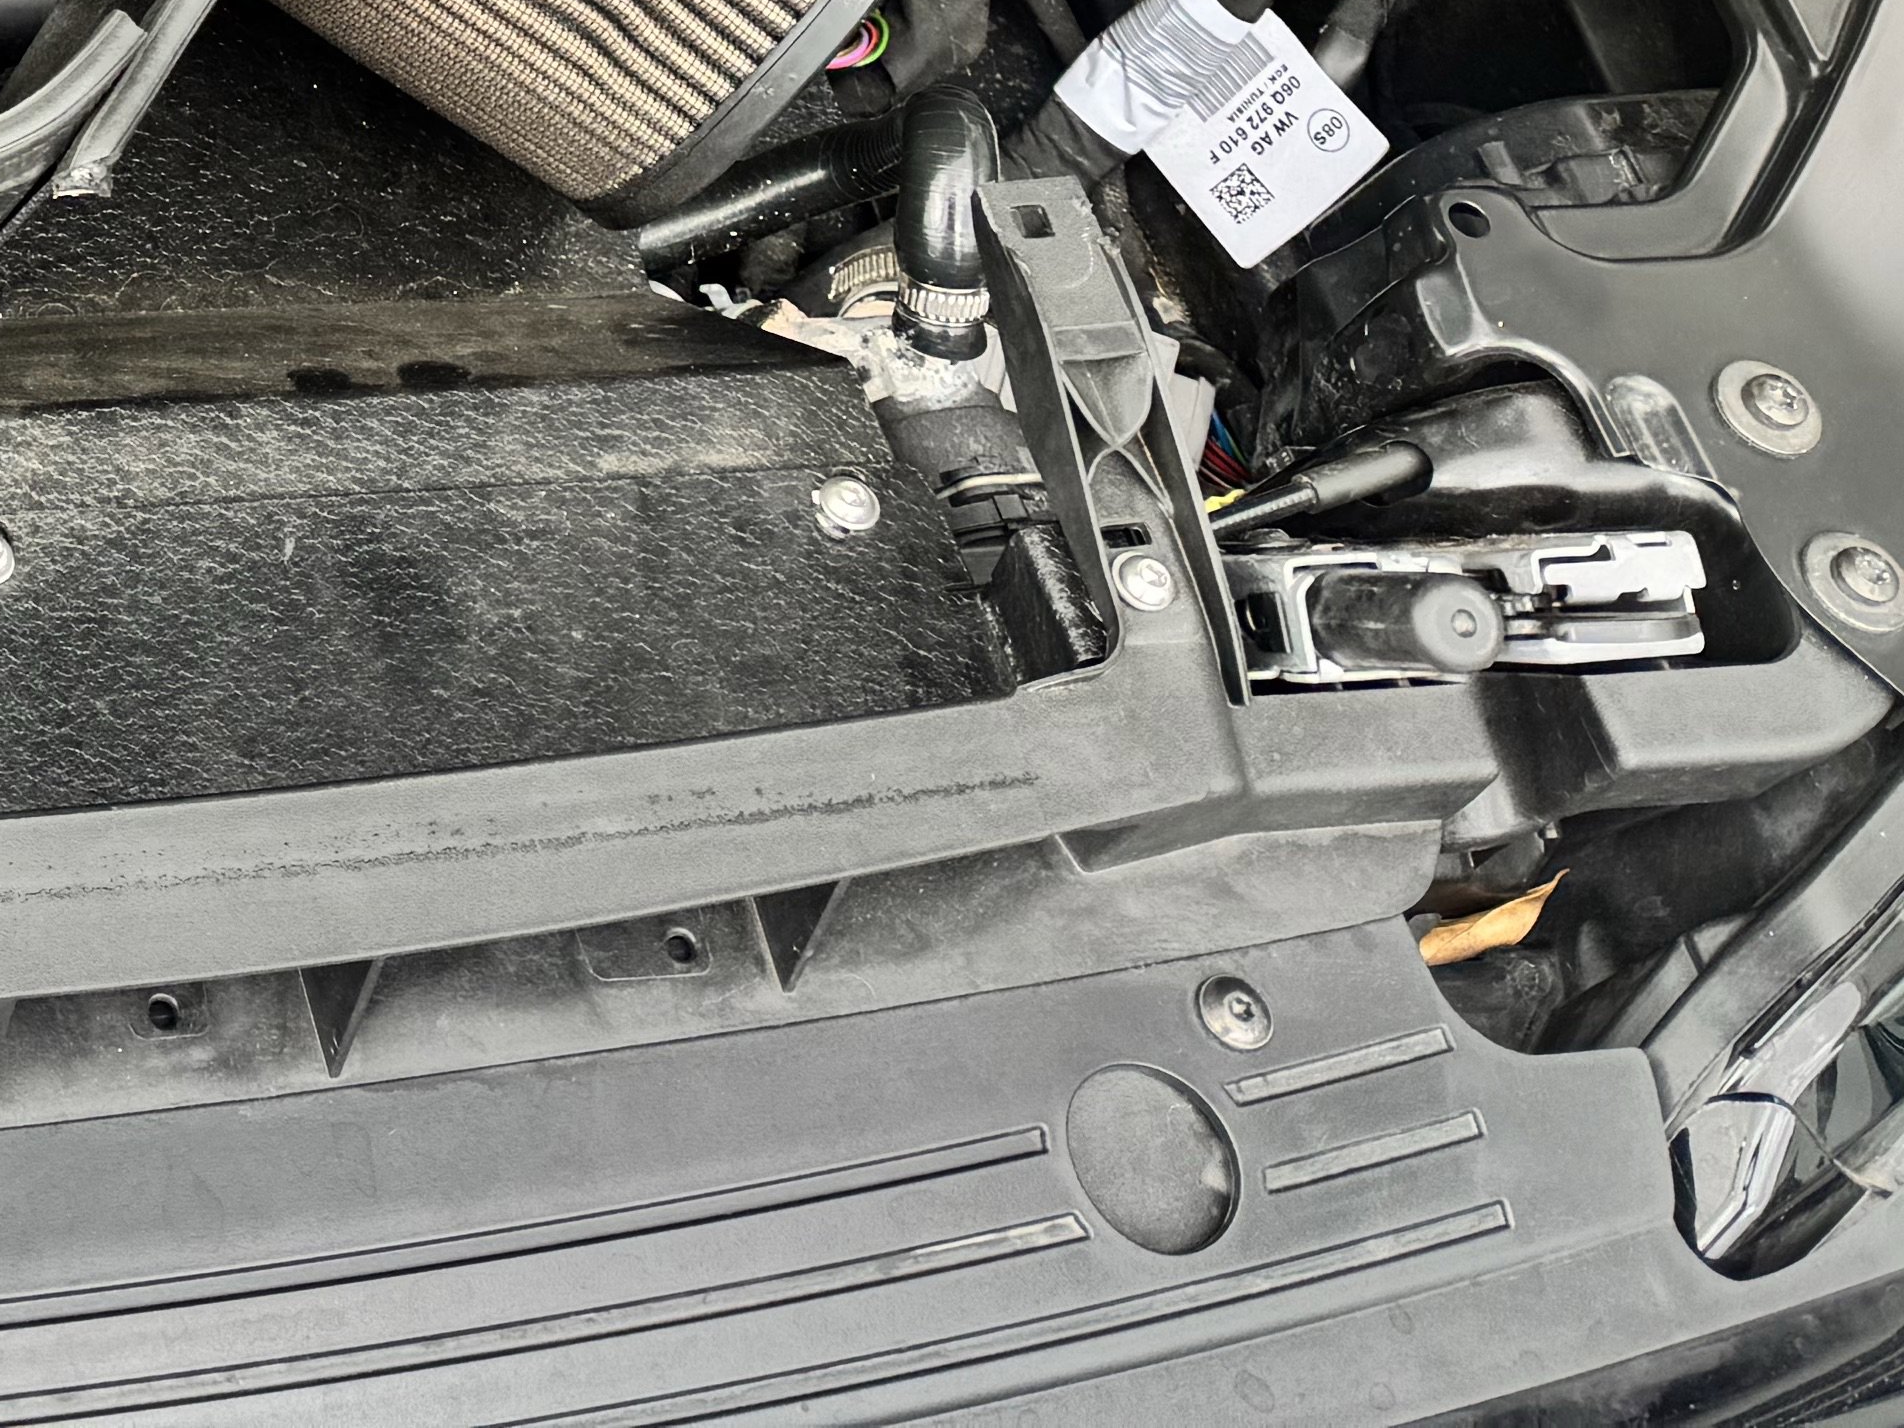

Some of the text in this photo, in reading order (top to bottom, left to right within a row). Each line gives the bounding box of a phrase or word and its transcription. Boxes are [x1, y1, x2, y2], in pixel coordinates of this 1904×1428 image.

[1208, 75, 1301, 166] 06Q 972 610 F
[1251, 111, 1299, 156] VW AG
[1313, 115, 1344, 145] 08S
